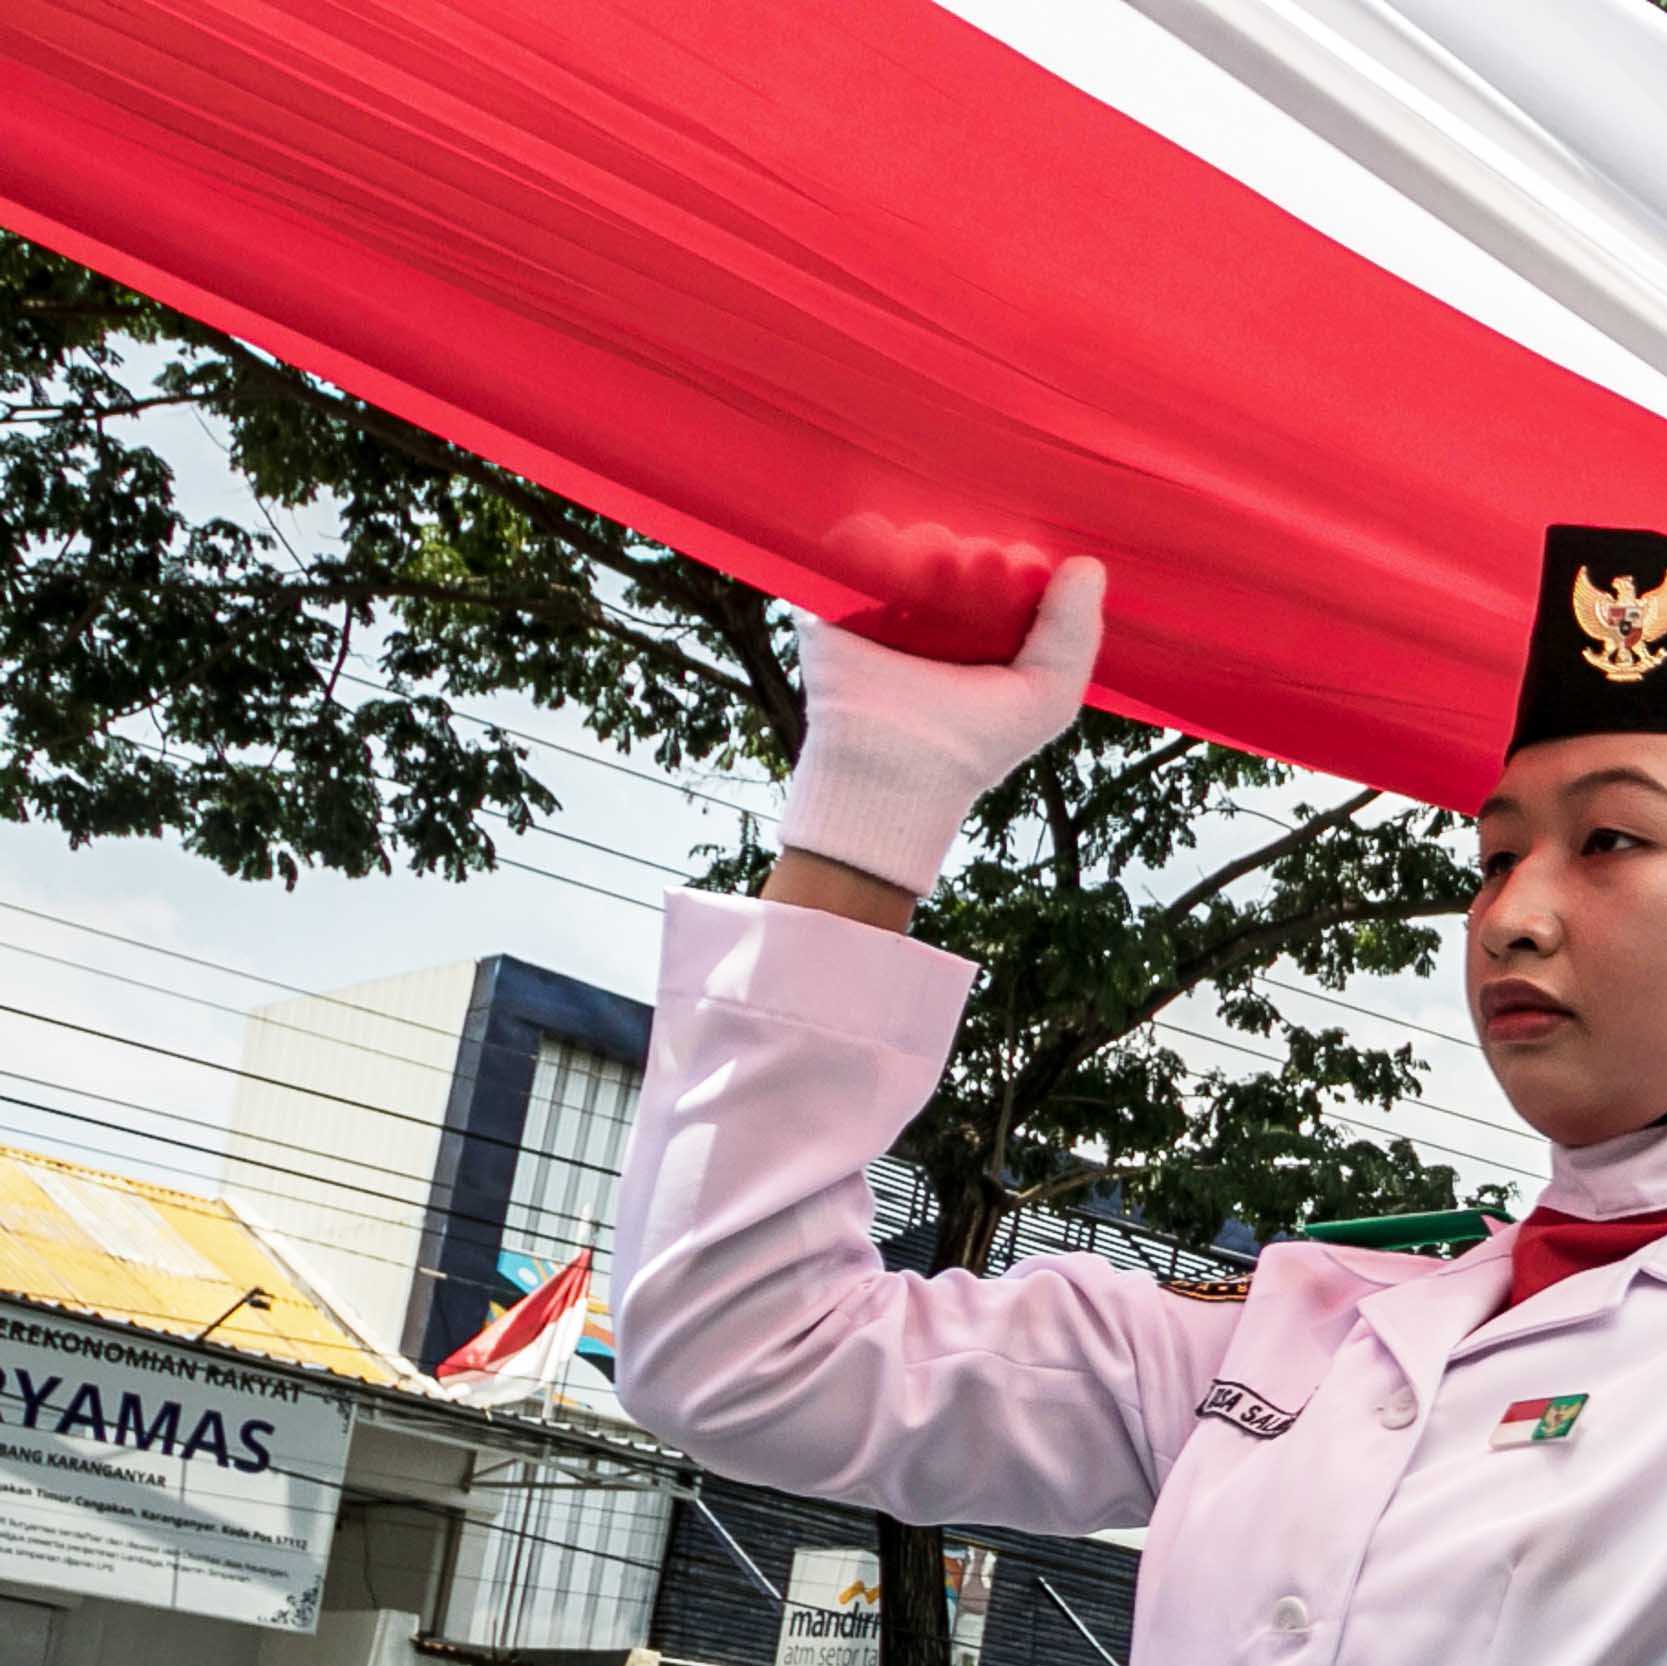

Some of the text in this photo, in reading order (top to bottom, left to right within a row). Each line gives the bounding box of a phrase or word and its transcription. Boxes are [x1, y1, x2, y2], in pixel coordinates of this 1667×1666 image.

[204, 1364, 301, 1404] RAKYAT
[0, 1366, 275, 1474] YAMAS
[47, 1453, 167, 1488] KARANGANYAR
[783, 1644, 815, 1666] atm
